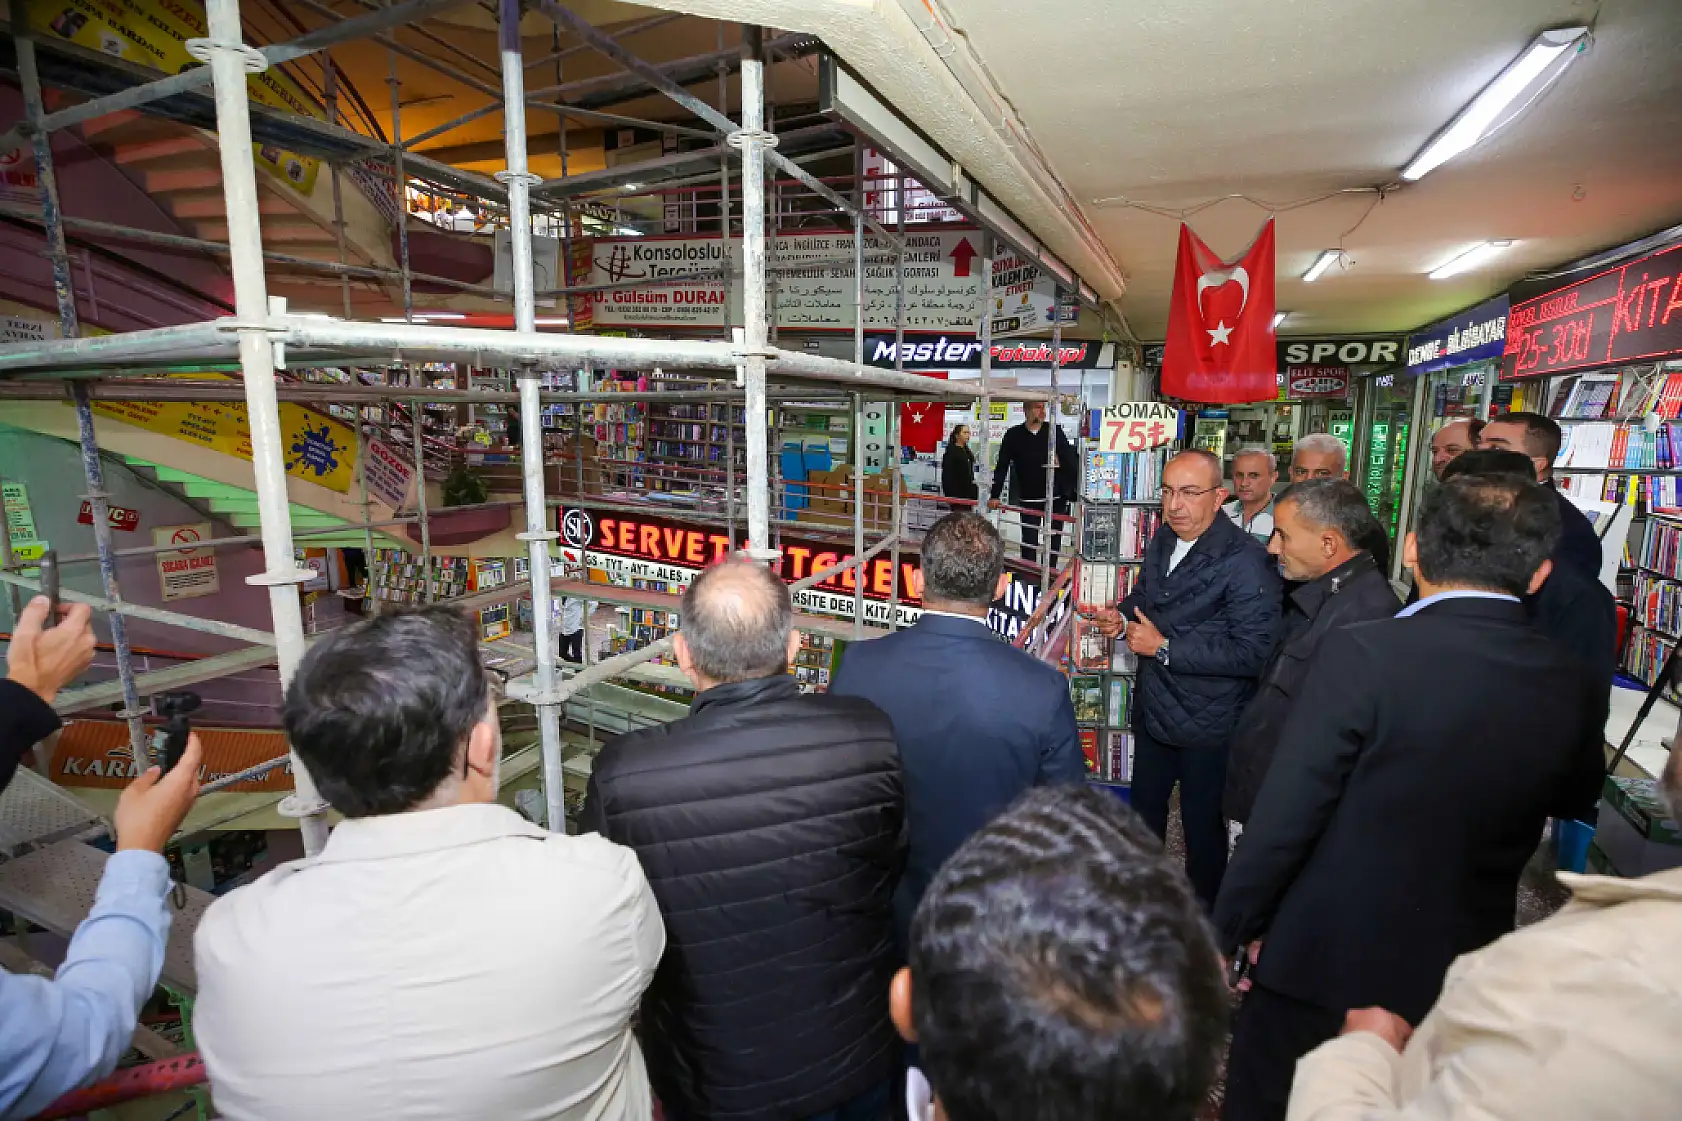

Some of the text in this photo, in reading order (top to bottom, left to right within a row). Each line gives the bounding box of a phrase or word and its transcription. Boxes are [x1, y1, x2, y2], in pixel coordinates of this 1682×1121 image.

[613, 289, 668, 304] Gülsüm
[872, 336, 982, 362] Master
[1285, 342, 1398, 364] SPOR
[1105, 403, 1176, 419] ROMAN
[600, 518, 730, 564] SERVET
[605, 558, 623, 571] TYT
[630, 562, 649, 576] AYT
[656, 567, 682, 582] ALES
[792, 590, 826, 609] RSİTE
